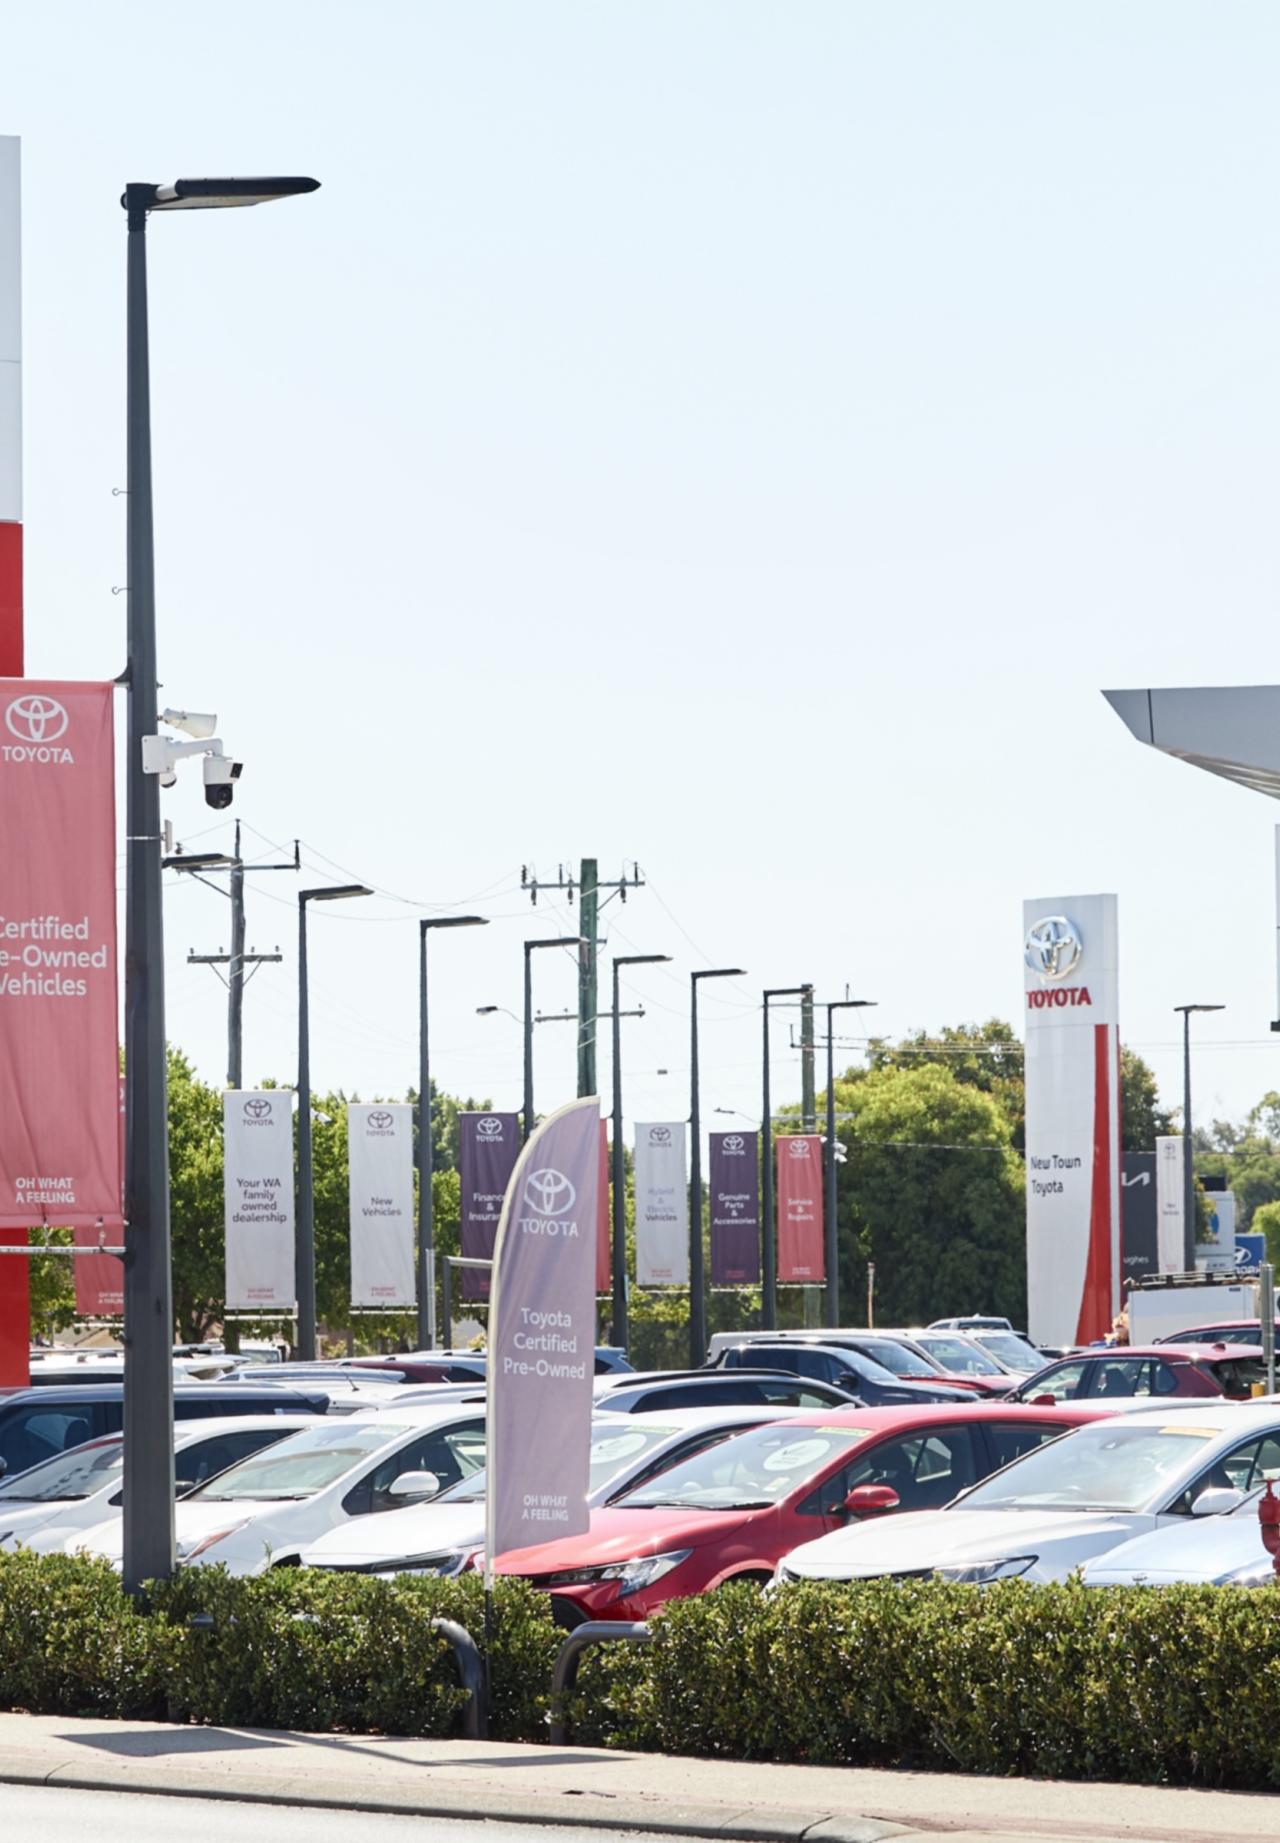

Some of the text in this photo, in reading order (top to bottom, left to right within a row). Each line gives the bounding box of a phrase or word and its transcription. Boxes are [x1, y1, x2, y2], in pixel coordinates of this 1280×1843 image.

[2, 746, 74, 764] TOYOTA
[1025, 987, 1092, 1009] TOYOTA
[243, 1118, 274, 1127] TOYOTA
[366, 1129, 395, 1137] TOYOTA
[1031, 1155, 1081, 1169] New Town
[15, 1176, 73, 1190] OH WHAT
[236, 1178, 281, 1189] Your WA
[1032, 1180, 1064, 1197] Toyota
[16, 1191, 75, 1204] A FEELING
[243, 1190, 275, 1201] family
[371, 1197, 393, 1206] New
[241, 1202, 277, 1212] owned
[362, 1207, 402, 1217] Vehicles
[232, 1212, 287, 1224] dealership
[519, 1217, 579, 1238] TOYOTA
[1123, 1256, 1149, 1265] ughes
[521, 1307, 571, 1329] Toyota
[513, 1332, 577, 1354] Certified
[503, 1357, 585, 1379] Pre-Owned
[523, 1494, 568, 1508] OH WHAT
[521, 1508, 569, 1522] A FEELING
